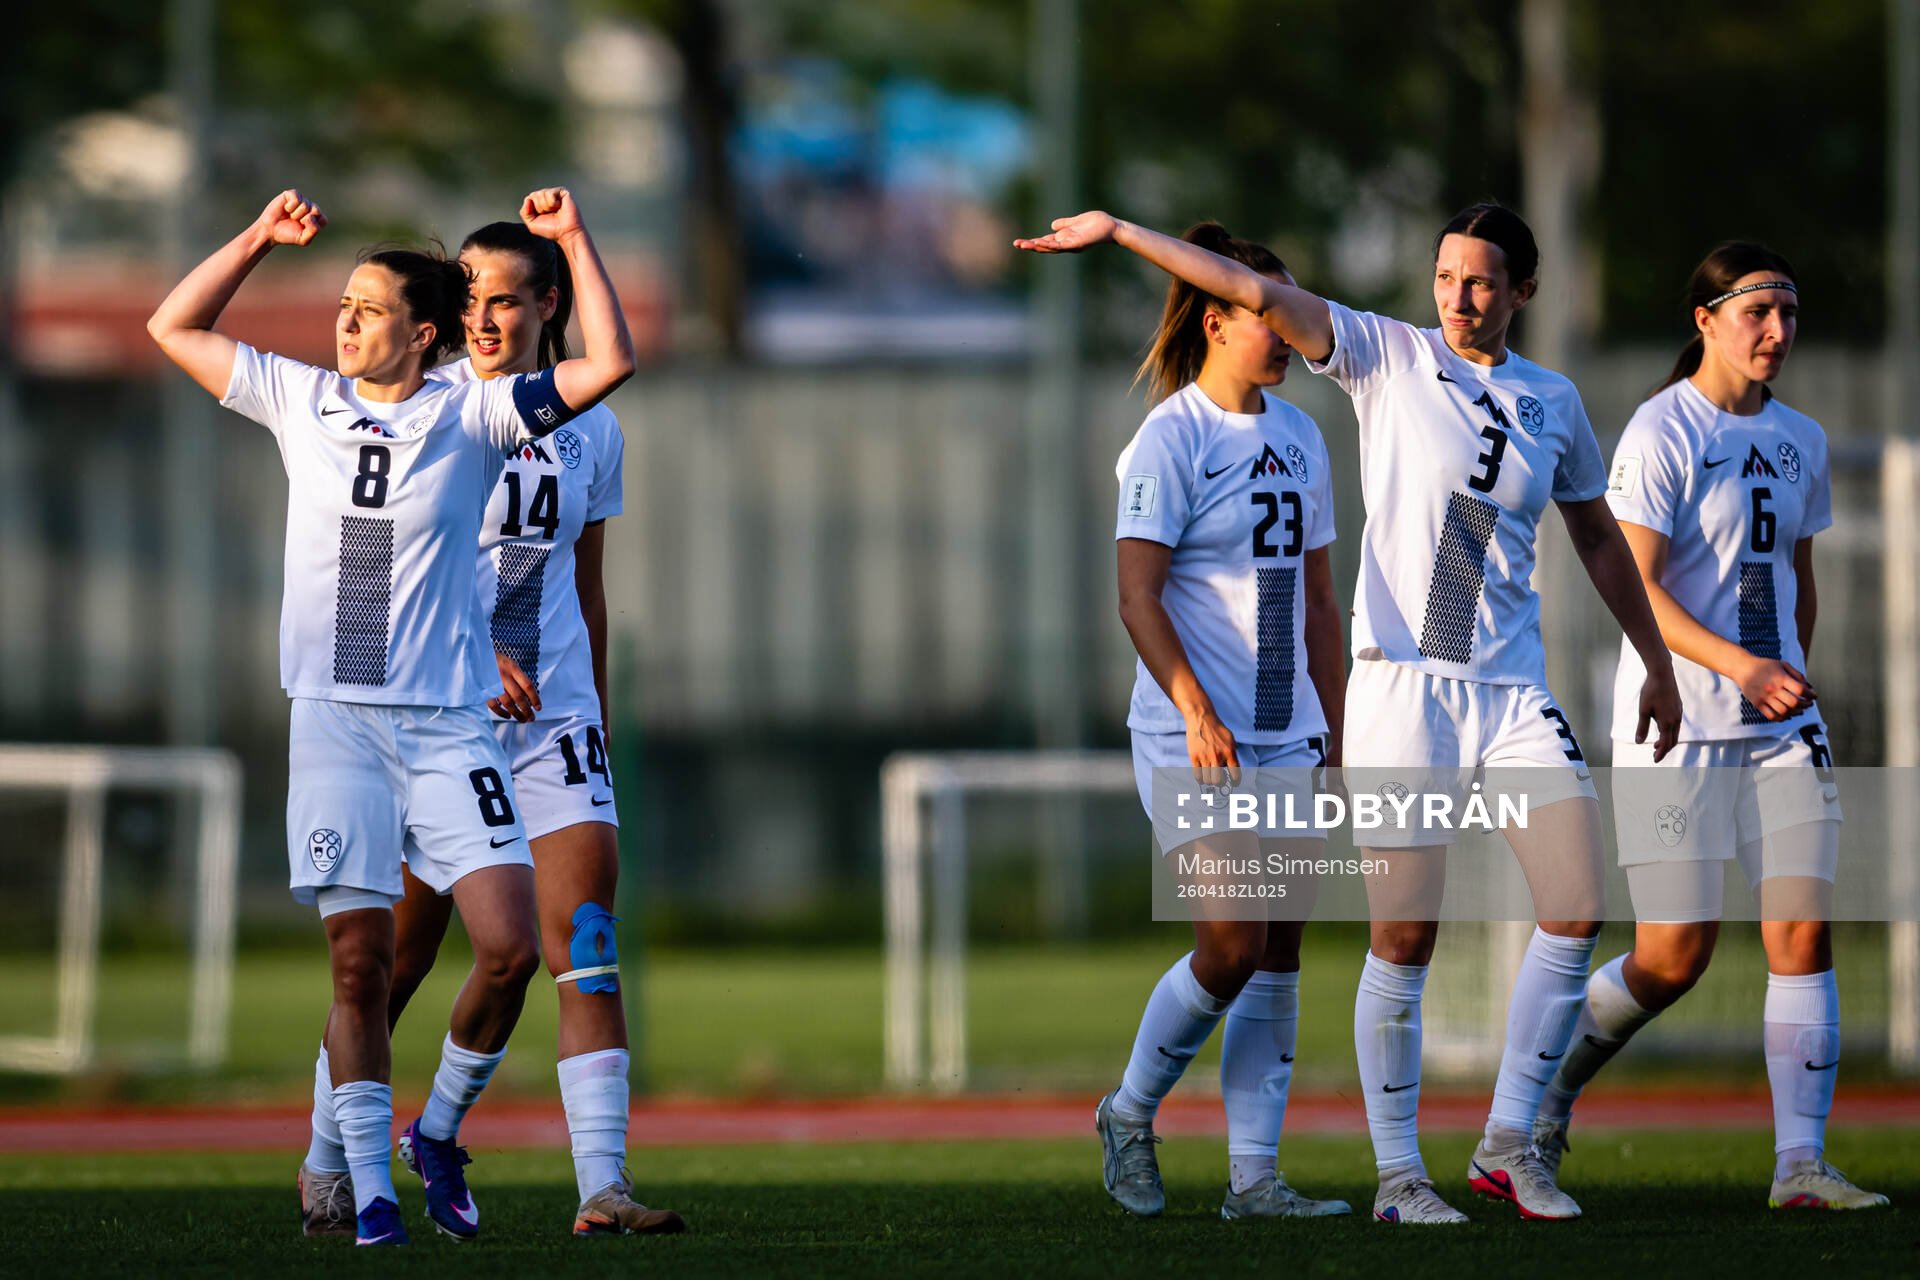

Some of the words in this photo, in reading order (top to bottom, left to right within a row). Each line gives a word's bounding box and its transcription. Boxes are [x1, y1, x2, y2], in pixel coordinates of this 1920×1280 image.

[352, 445, 391, 508] 8
[1469, 426, 1508, 493] 3
[499, 472, 560, 541] 14
[1251, 491, 1304, 557] 23
[1750, 487, 1776, 553] 6
[554, 725, 612, 787] 14
[1540, 707, 1584, 762] 3
[1799, 724, 1835, 784] 6
[469, 766, 516, 828] 8
